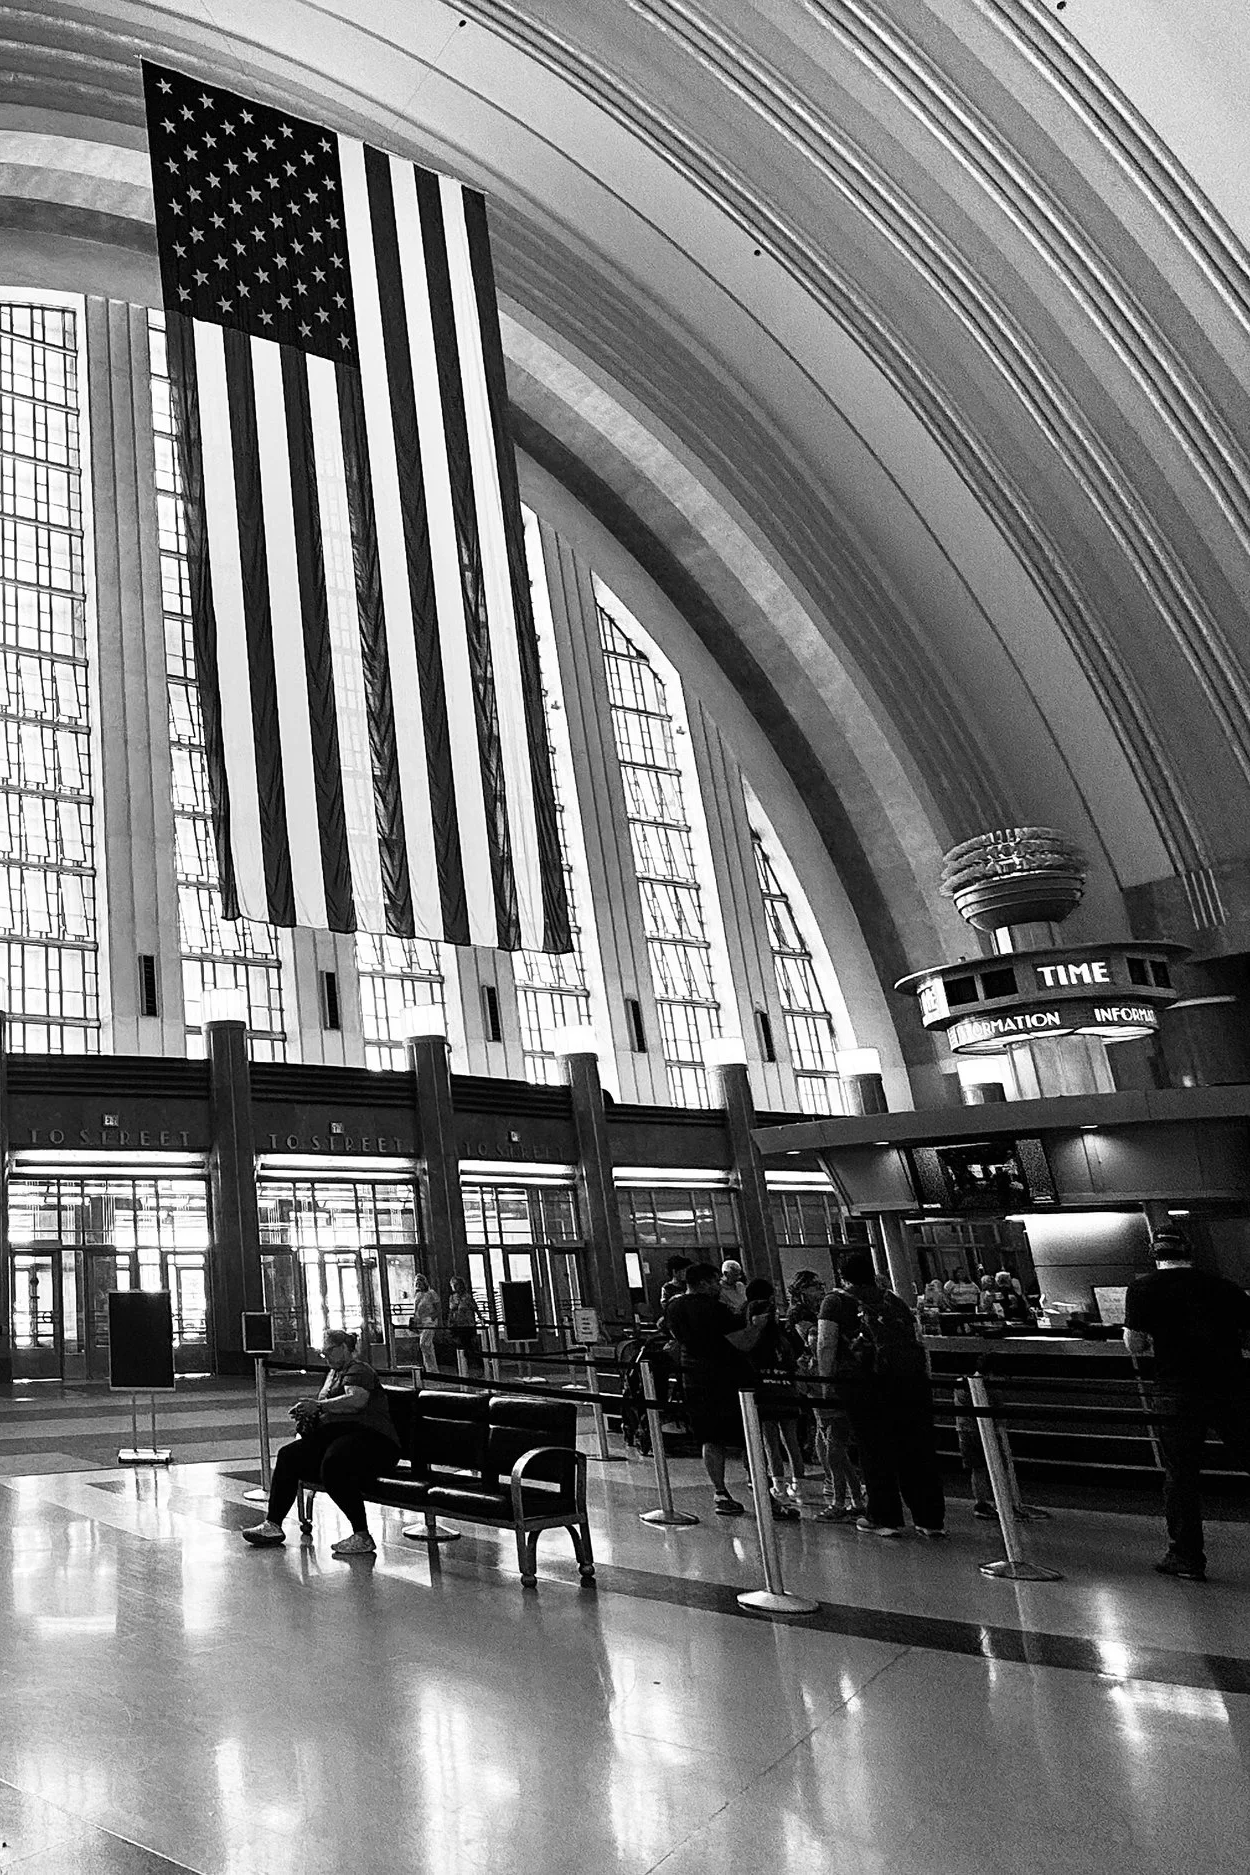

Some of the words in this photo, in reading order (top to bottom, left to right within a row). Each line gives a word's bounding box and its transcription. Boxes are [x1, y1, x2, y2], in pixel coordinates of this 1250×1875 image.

[1036, 961, 1110, 987] TIME
[29, 1128, 65, 1145] TO
[79, 1128, 190, 1147] STREET
[268, 1133, 299, 1150] TO
[311, 1135, 404, 1153] STREET
